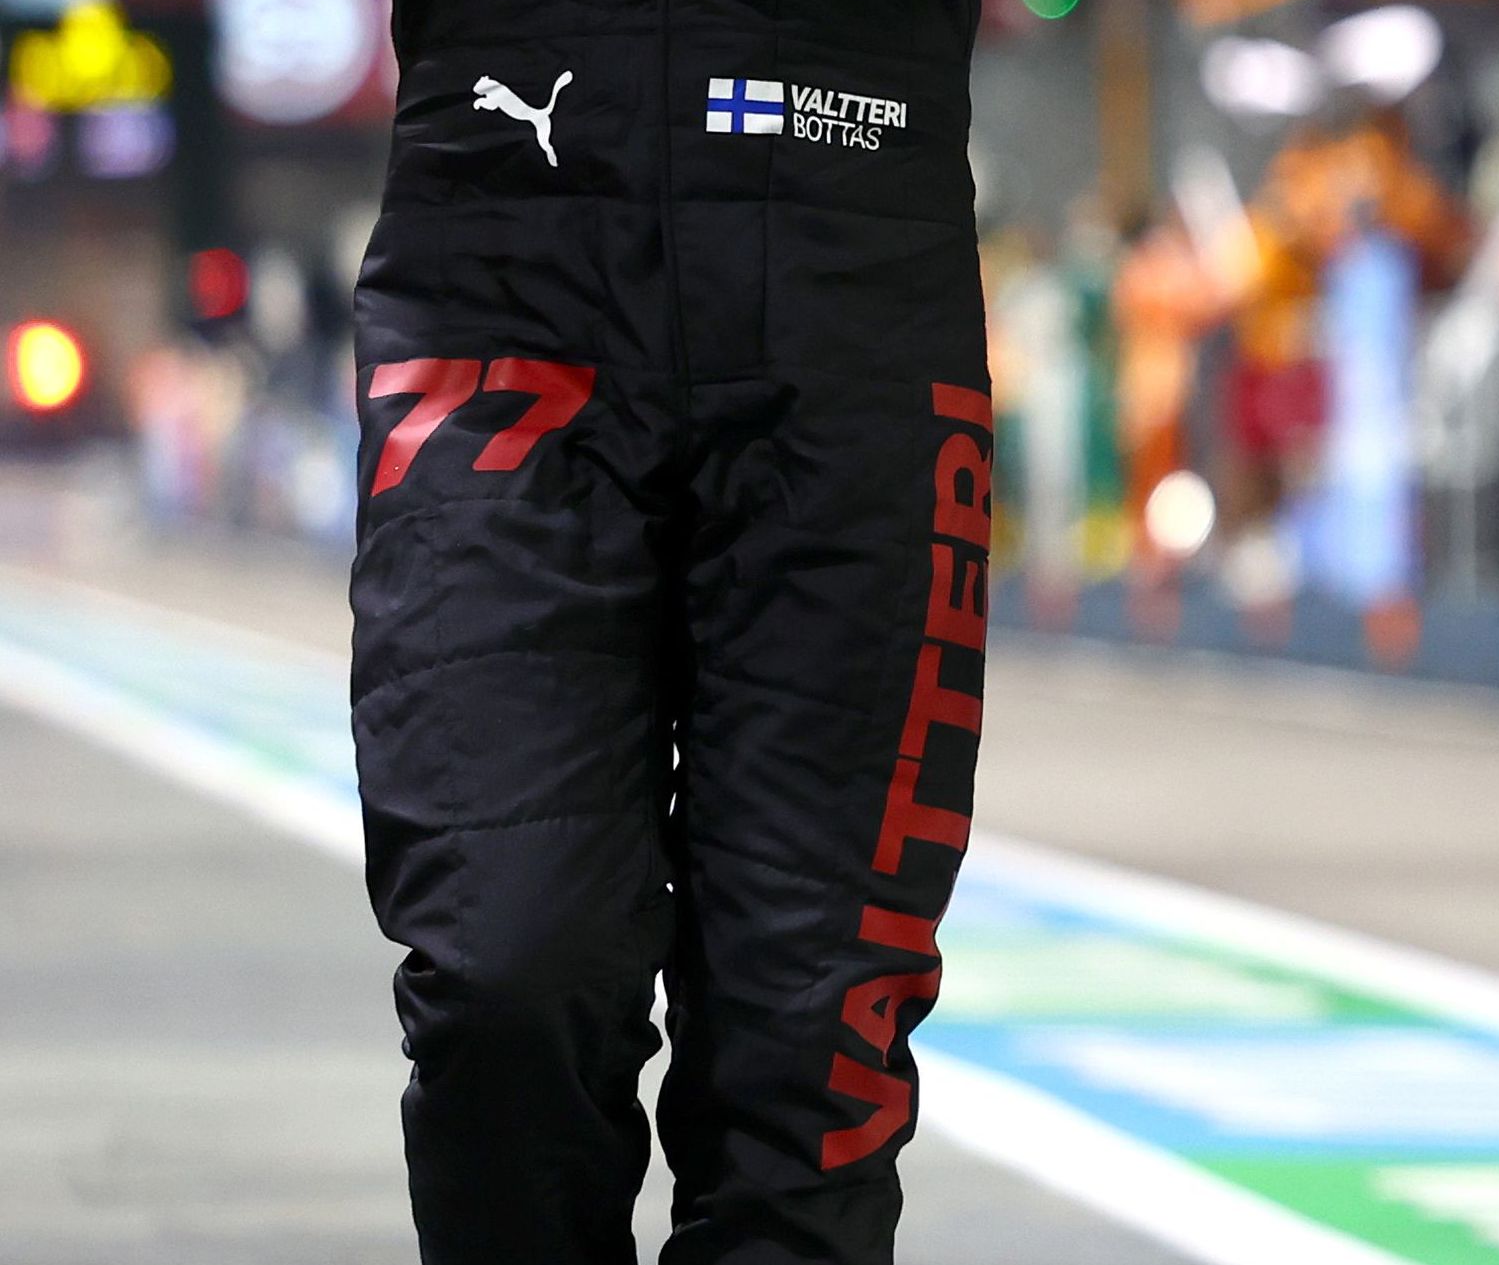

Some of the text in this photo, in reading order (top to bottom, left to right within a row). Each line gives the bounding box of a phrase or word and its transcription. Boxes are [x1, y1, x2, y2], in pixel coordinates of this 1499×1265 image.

[791, 84, 907, 128] VALTTERI
[793, 112, 882, 150] BOTTAS
[368, 357, 596, 497] 77
[820, 382, 992, 1170] VALTTERI
